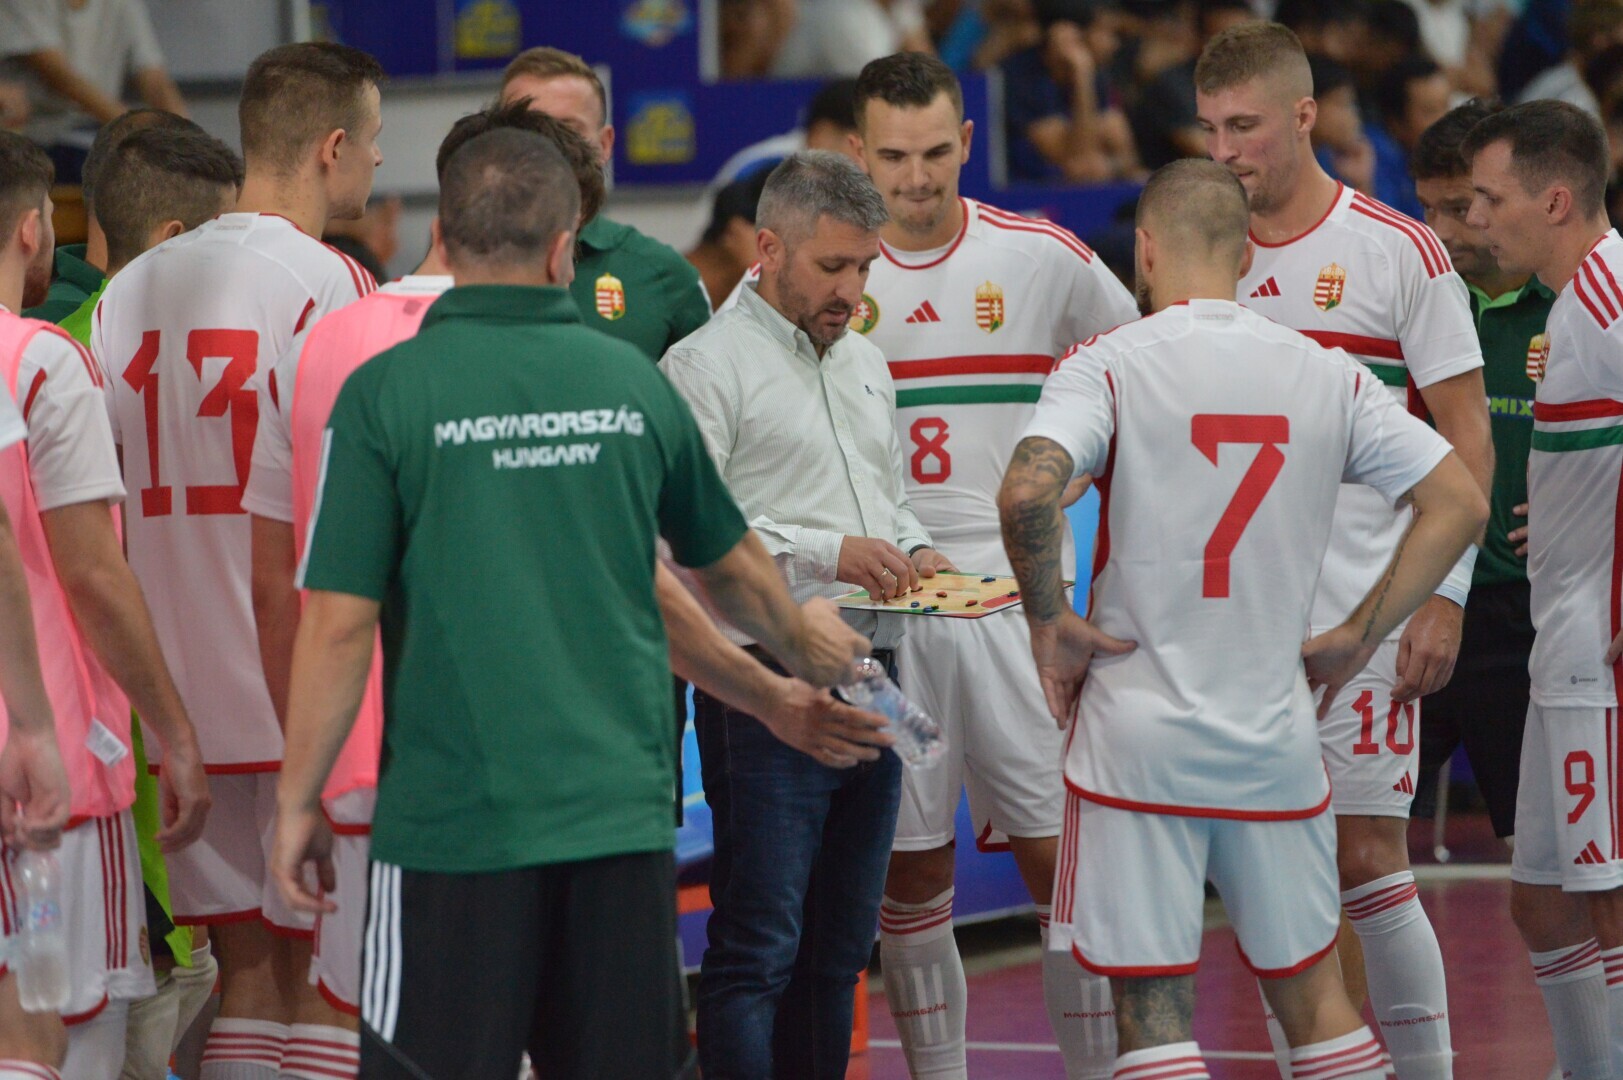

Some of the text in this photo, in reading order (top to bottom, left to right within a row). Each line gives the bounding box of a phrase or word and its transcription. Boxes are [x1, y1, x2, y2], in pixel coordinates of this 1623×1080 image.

[122, 328, 259, 518] 13
[434, 404, 645, 447] MAGYARORSZÁG
[492, 442, 602, 470] HUNGARY
[910, 417, 951, 484] 8
[1191, 414, 1289, 598] 7
[1350, 689, 1415, 756] 10
[1564, 750, 1596, 824] 9
